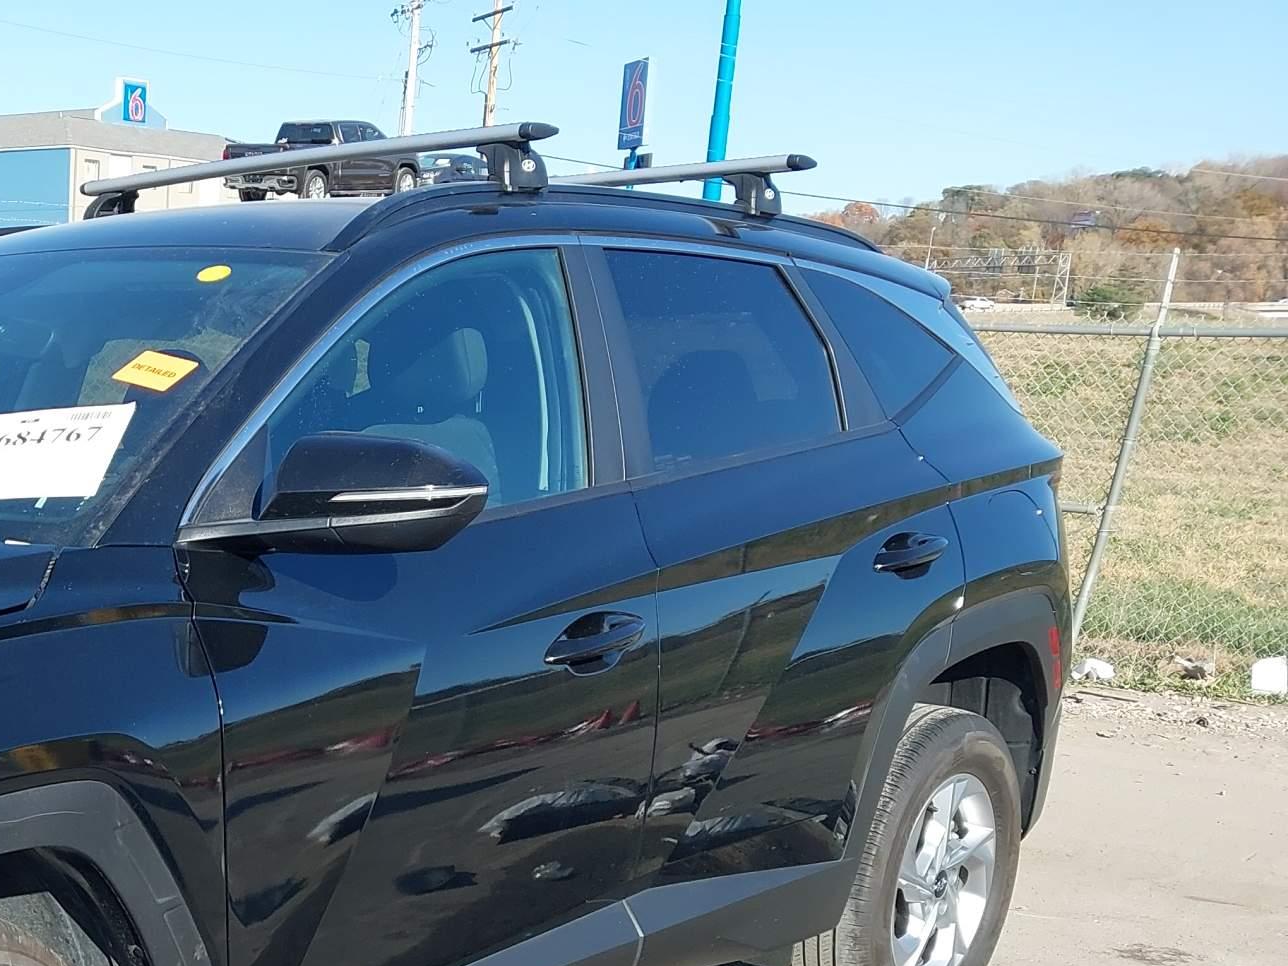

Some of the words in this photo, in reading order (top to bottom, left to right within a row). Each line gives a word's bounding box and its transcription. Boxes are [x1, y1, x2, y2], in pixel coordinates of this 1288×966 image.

[128, 87, 145, 121] 6
[626, 61, 645, 128] 6
[131, 362, 177, 378] DETAILED
